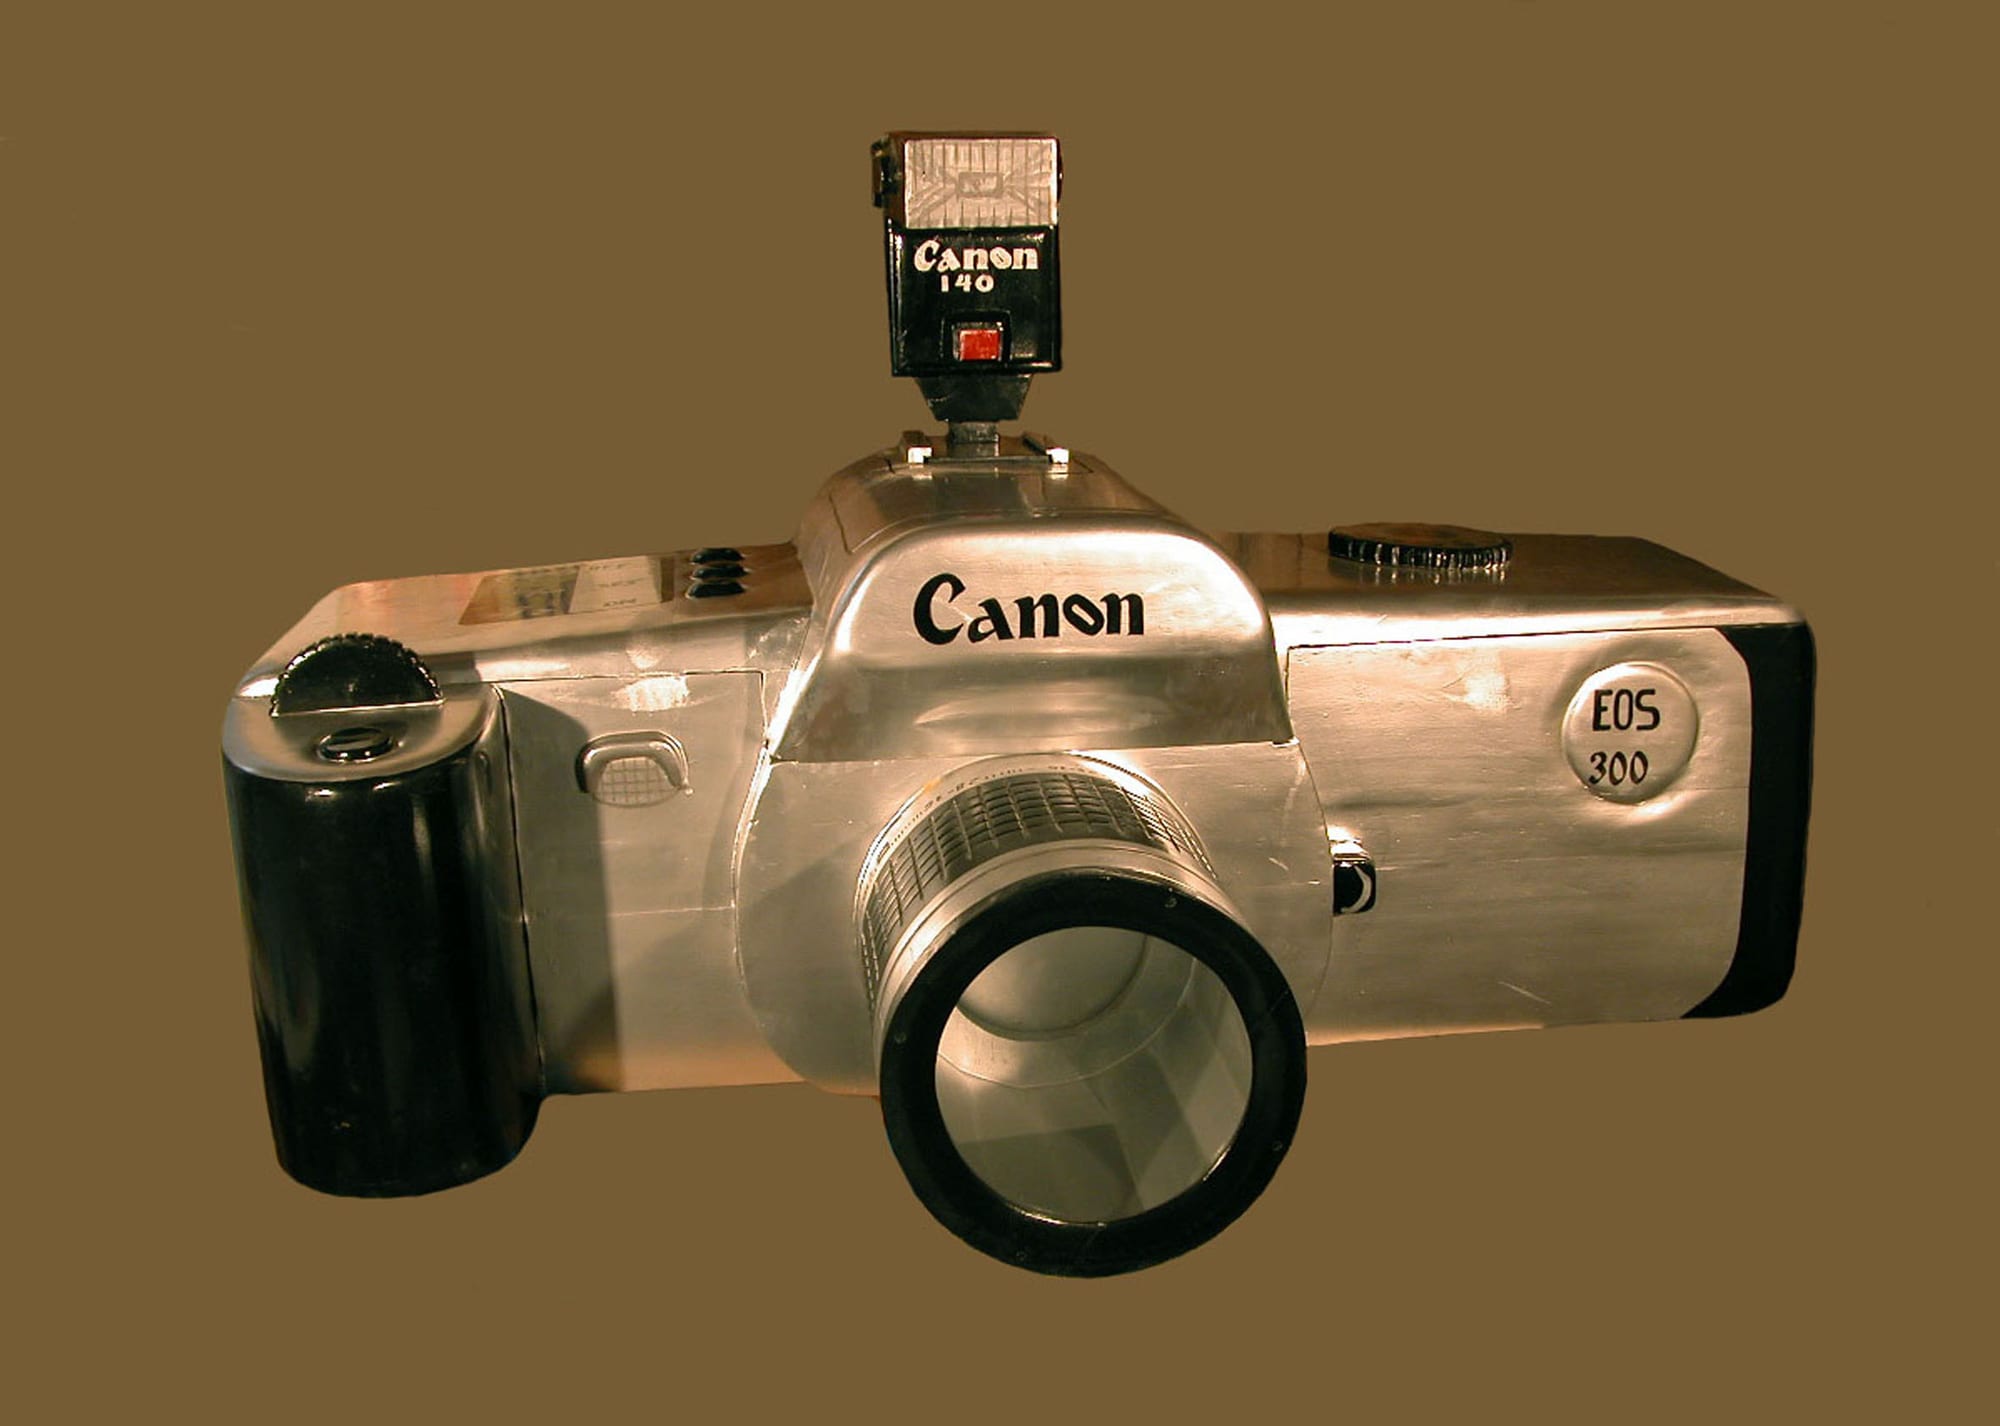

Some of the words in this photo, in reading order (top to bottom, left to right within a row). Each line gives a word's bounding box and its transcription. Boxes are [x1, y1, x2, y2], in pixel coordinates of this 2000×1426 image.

[913, 239, 1039, 273] Canon
[941, 273, 995, 293] 140
[913, 572, 1145, 646] Canon
[1592, 688, 1661, 732] EOS
[1588, 750, 1649, 786] 300
